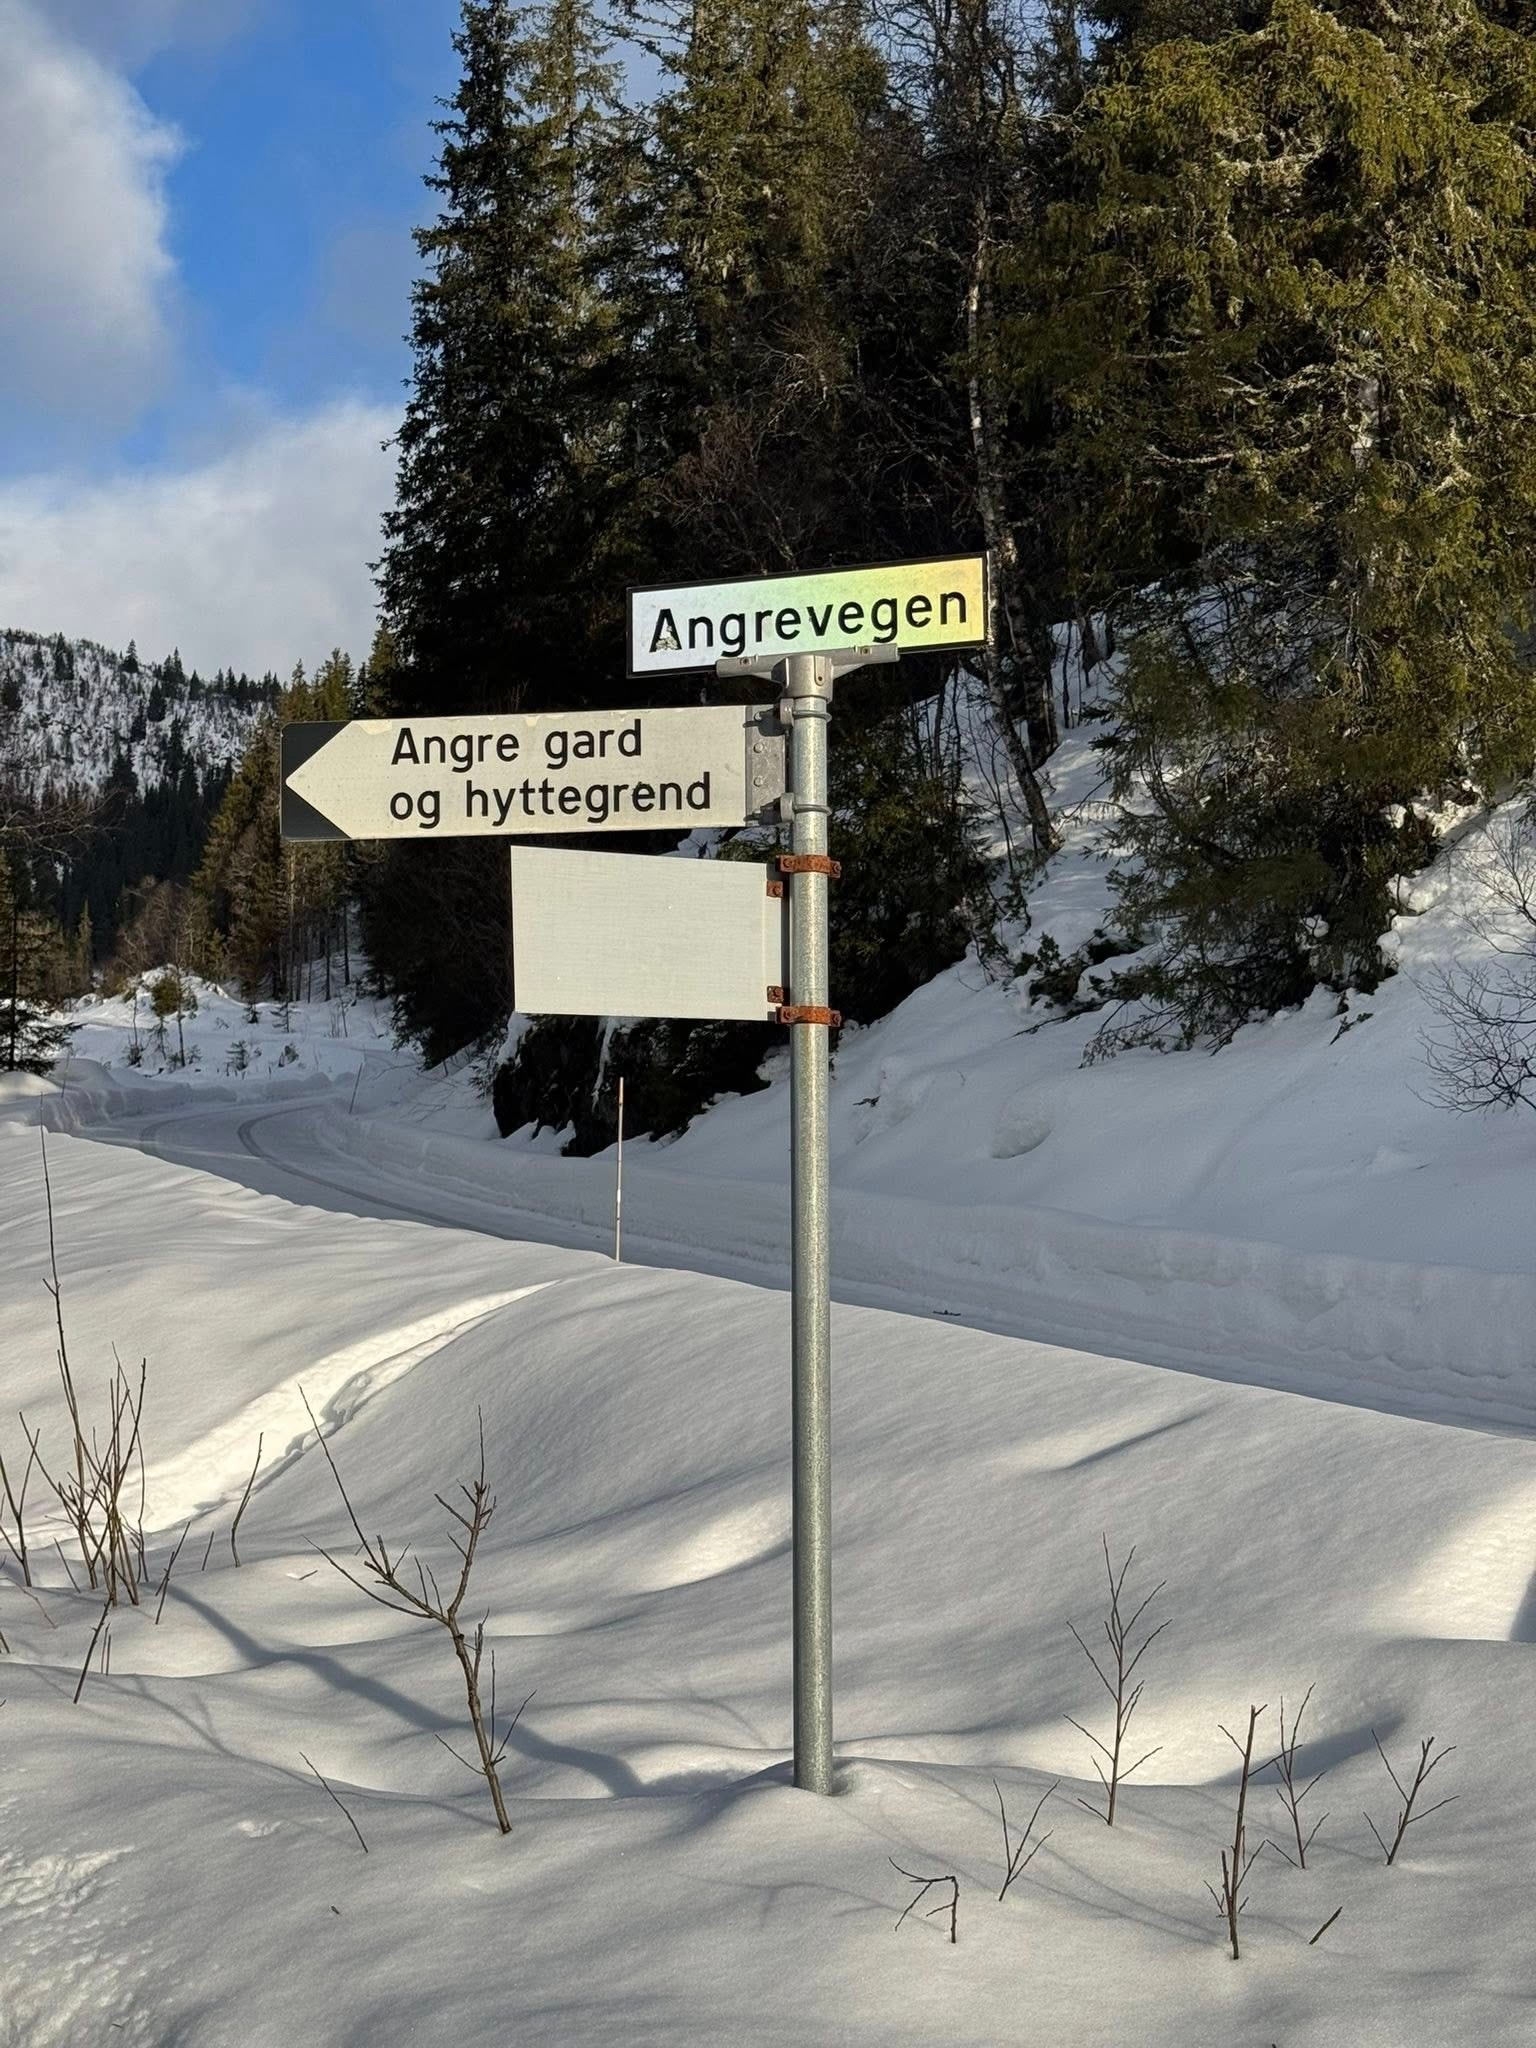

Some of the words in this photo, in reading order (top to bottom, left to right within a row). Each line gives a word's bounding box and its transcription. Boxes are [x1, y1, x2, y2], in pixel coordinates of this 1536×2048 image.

[648, 589, 967, 657] Angrevegen
[390, 726, 520, 773] Angre
[544, 719, 642, 770] gard
[389, 788, 441, 829] og
[465, 771, 711, 826] hyttegrend
